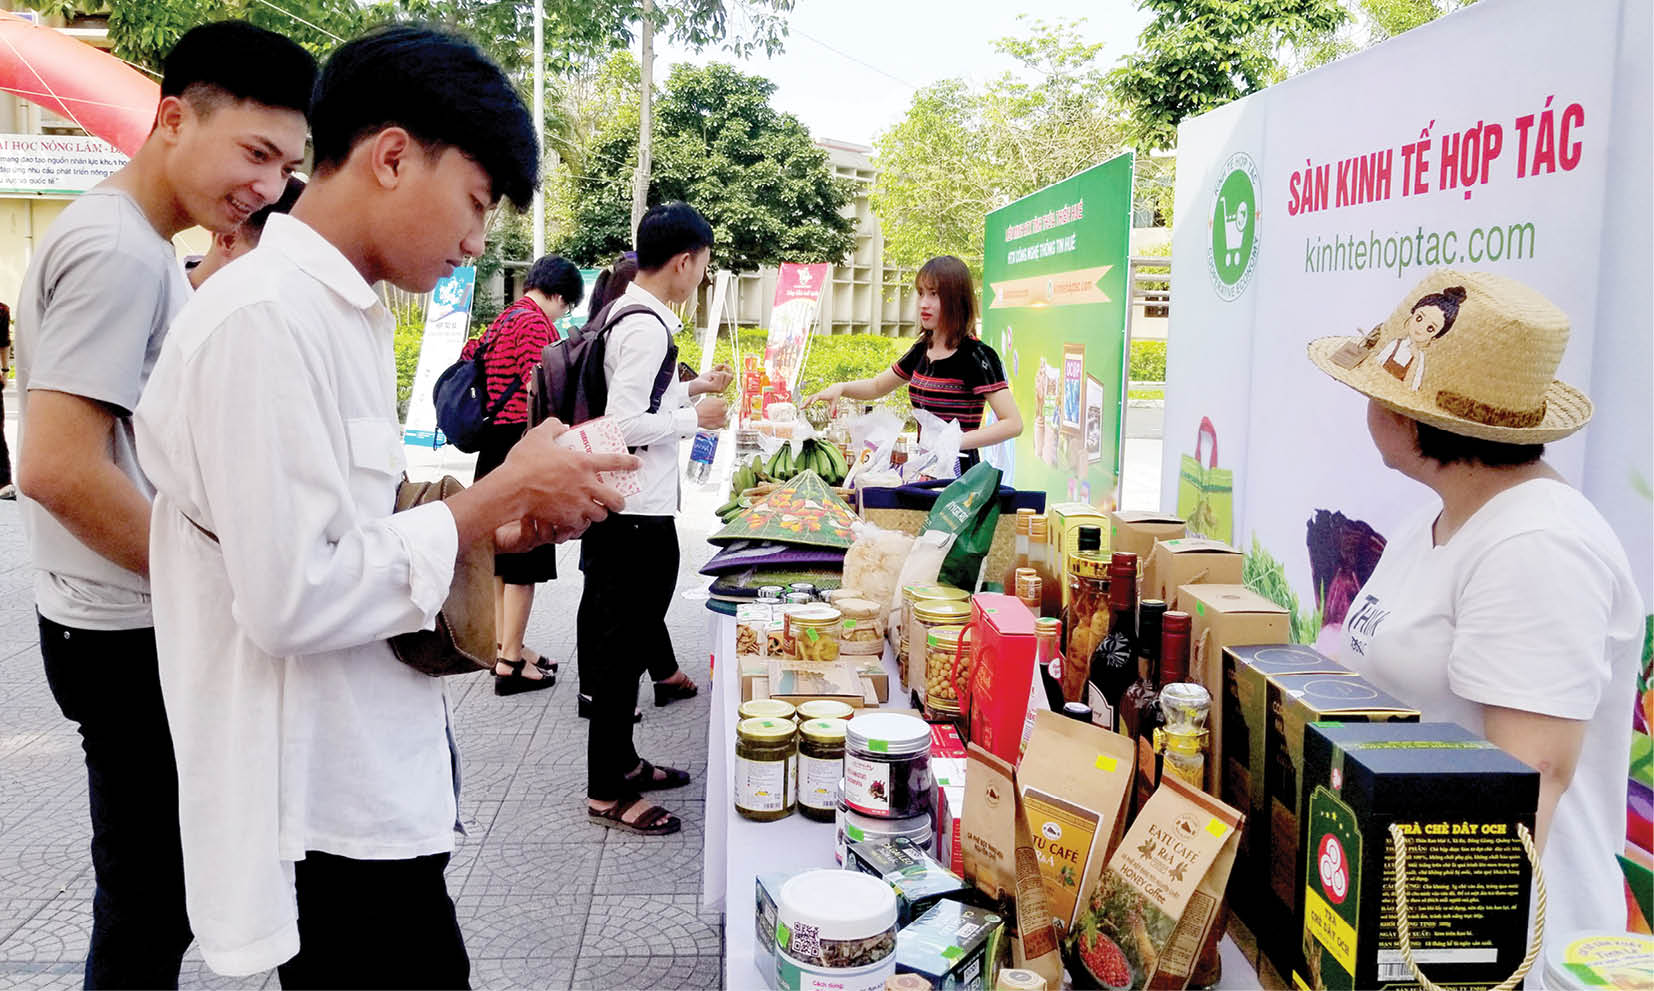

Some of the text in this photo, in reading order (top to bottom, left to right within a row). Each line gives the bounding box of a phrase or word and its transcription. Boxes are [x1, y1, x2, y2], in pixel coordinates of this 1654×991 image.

[41, 140, 73, 152] NÔNG
[76, 142, 102, 153] LÂM
[1288, 94, 1584, 216] SÀN KINH TẾ HỢP TÁC
[1305, 221, 1536, 278] kinhtehoptac.com
[1424, 821, 1450, 835] CHÈ
[1452, 821, 1478, 835] DÂY
[1481, 824, 1507, 834] OCH
[1049, 843, 1079, 864] CAFÉ
[1173, 841, 1201, 864] CAFÉ
[1120, 863, 1146, 888] HONEY
[1144, 883, 1166, 905] Coffee
